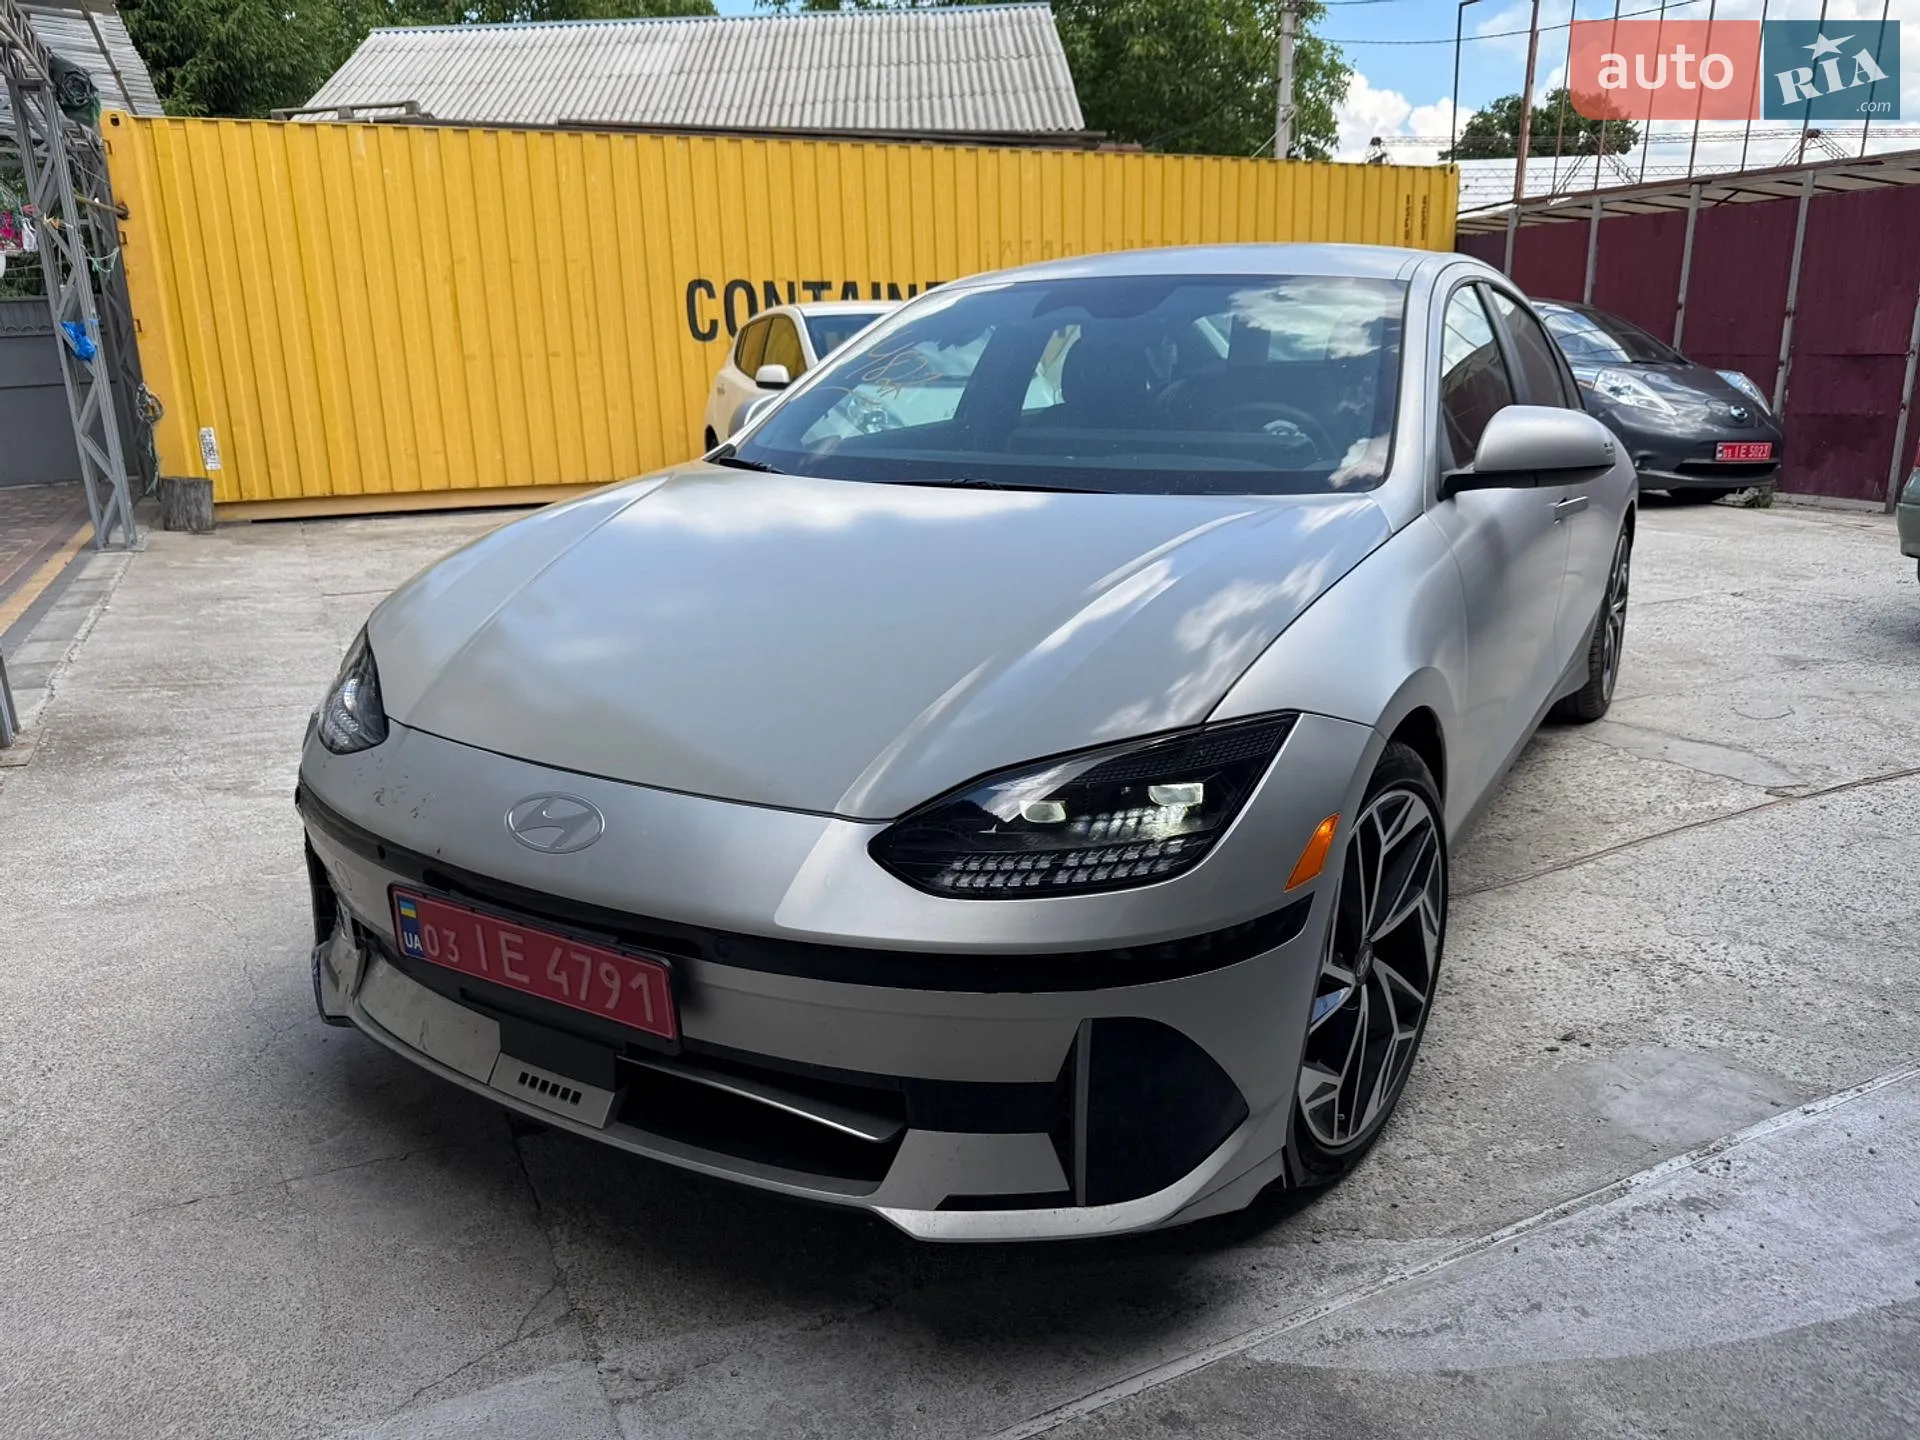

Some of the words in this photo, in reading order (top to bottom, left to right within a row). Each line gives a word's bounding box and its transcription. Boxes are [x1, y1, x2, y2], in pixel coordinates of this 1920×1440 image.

[1734, 445, 1747, 458] IE
[403, 930, 423, 951] UA
[423, 923, 461, 963] 03
[474, 923, 531, 984] IE
[546, 946, 654, 1023] 4791
